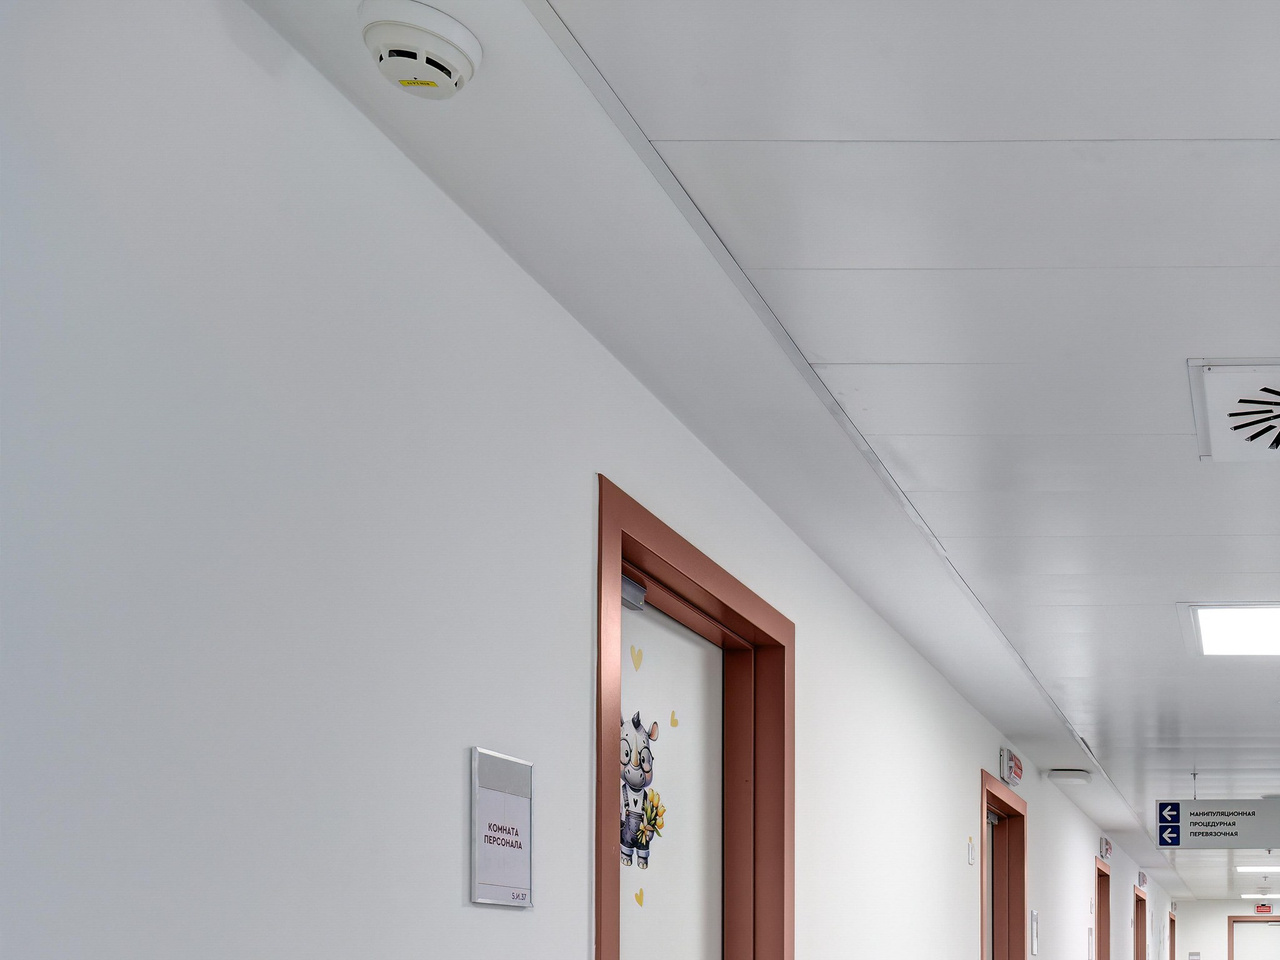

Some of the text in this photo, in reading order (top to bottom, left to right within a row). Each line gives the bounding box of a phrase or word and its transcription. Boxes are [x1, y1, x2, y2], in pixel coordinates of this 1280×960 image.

[1189, 810, 1256, 818] МАНИПУЛЯЦИОННАЯ
[487, 822, 519, 837] КОМНАТА
[483, 834, 523, 850] ПЕРСОНАЛА
